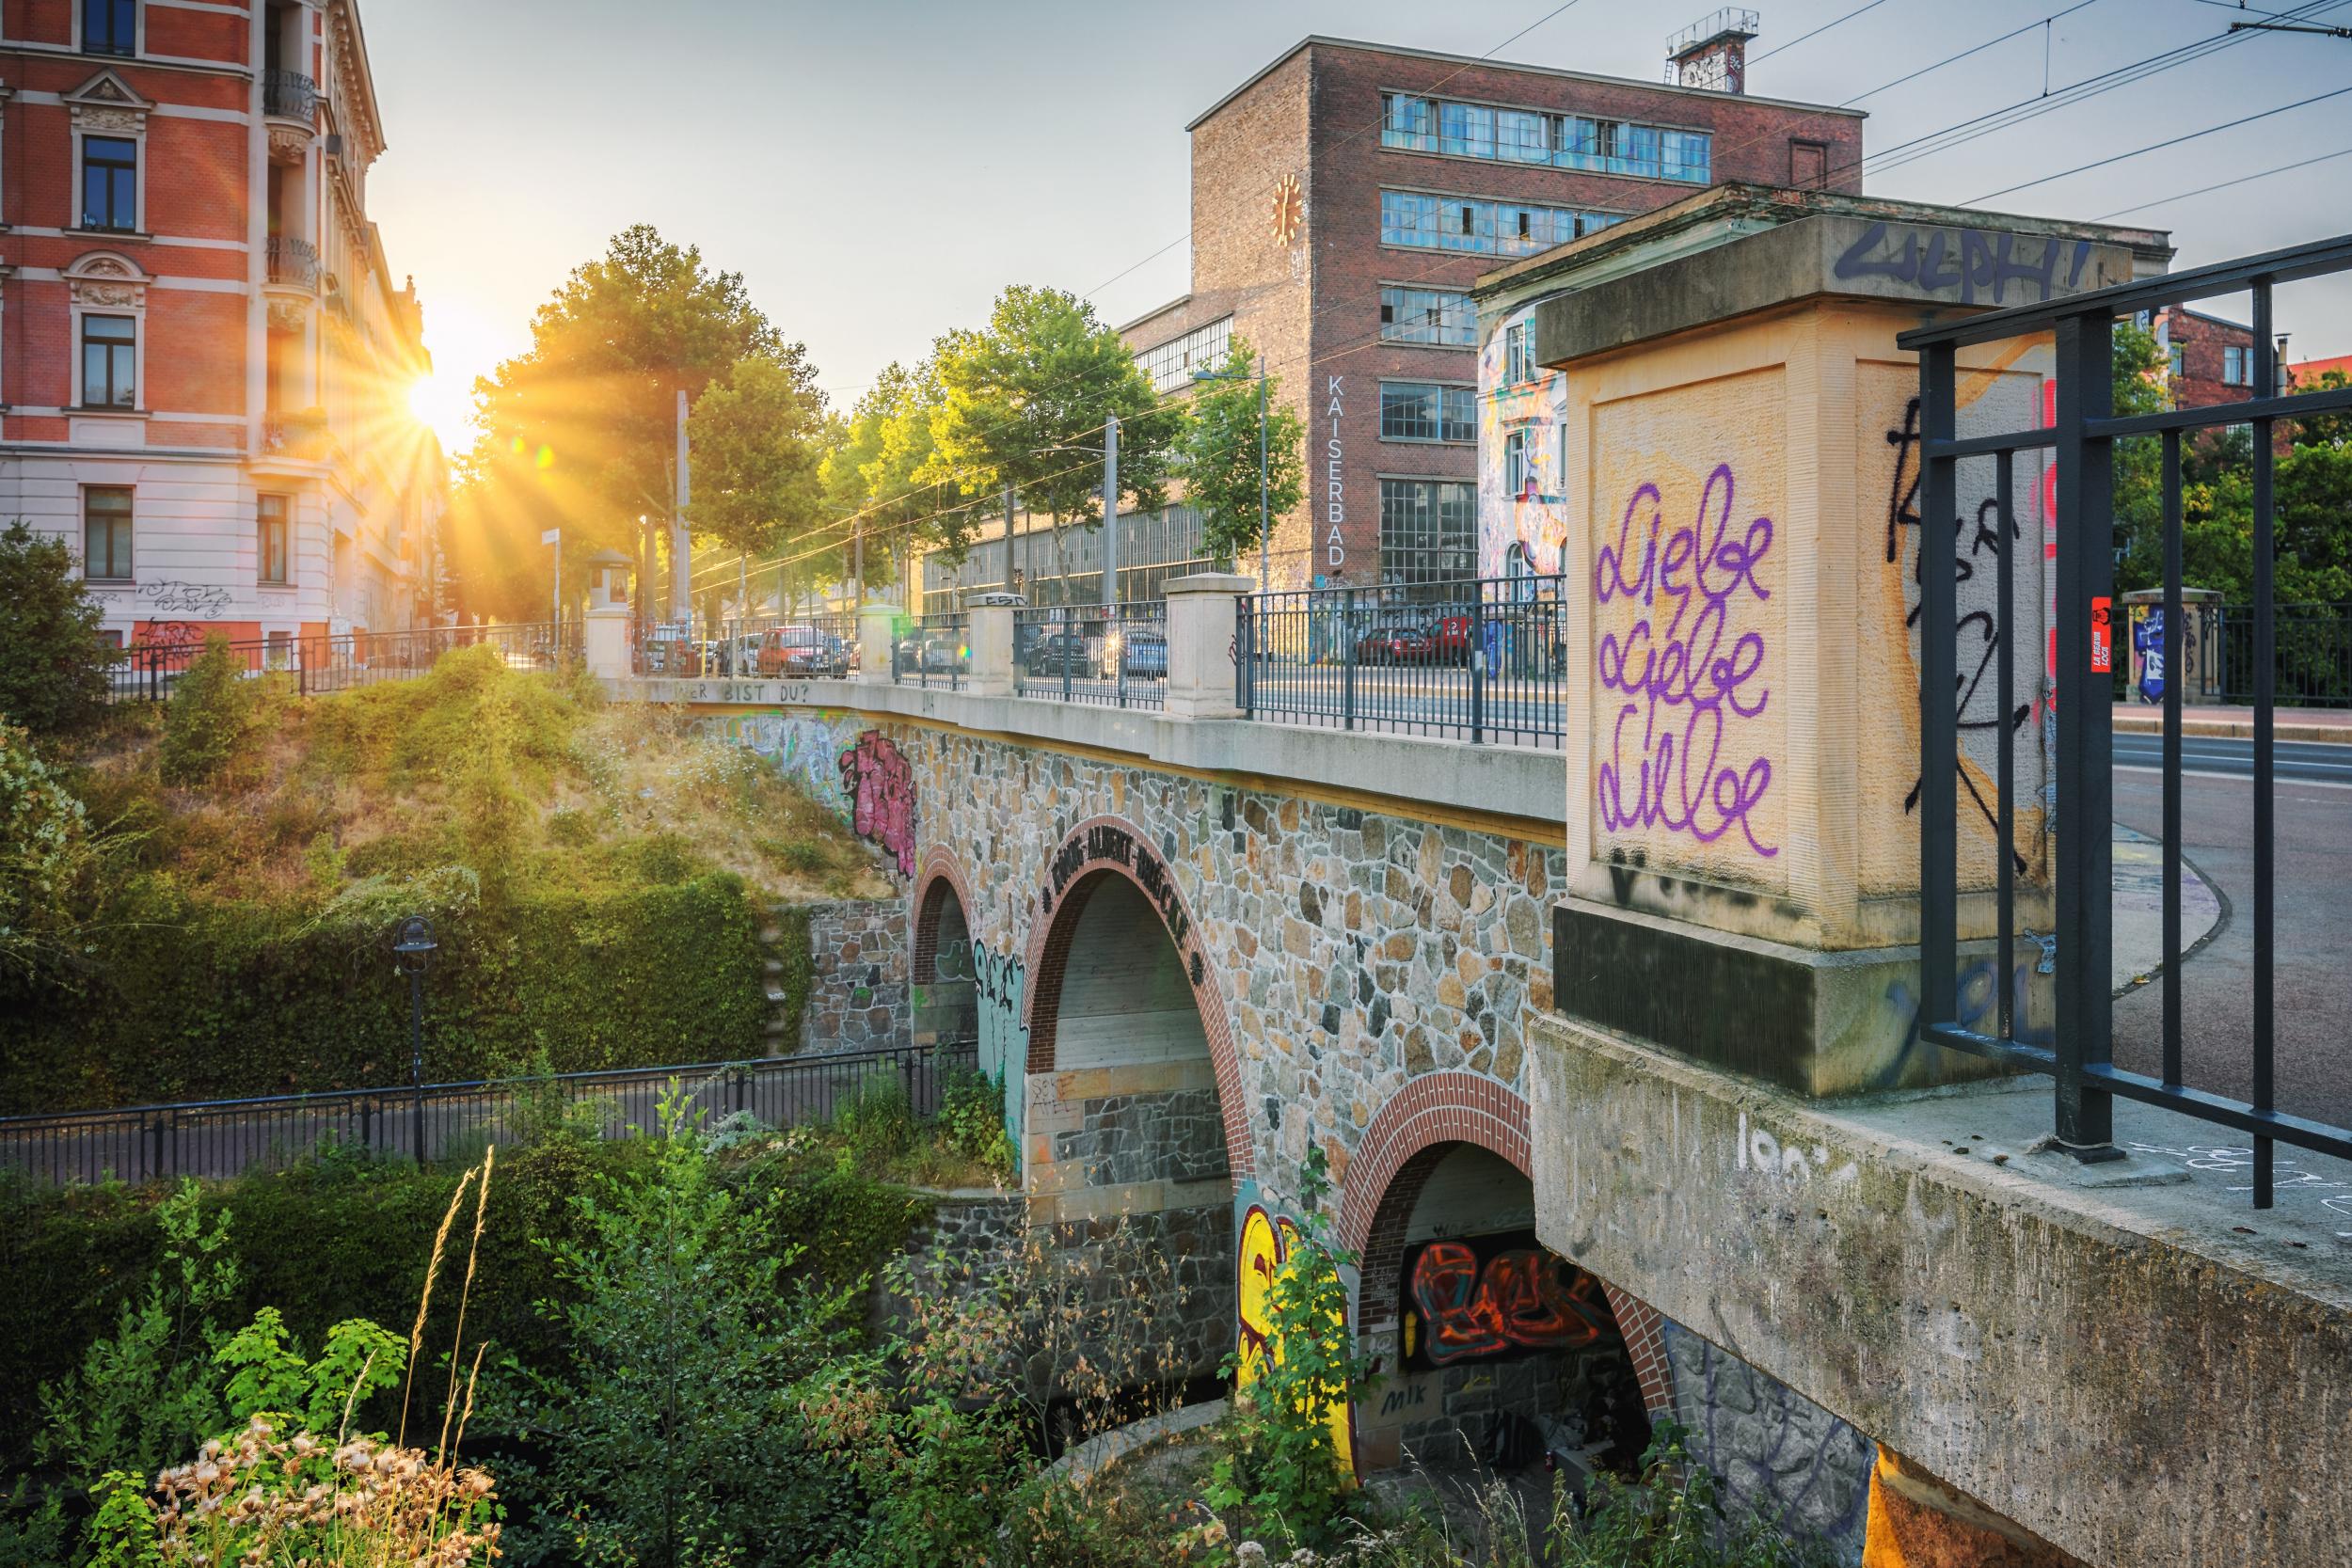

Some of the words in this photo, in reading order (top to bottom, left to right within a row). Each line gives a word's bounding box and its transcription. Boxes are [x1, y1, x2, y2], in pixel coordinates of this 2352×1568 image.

[1327, 375, 1344, 566] KAISERBAD
[1597, 463, 1772, 606] Liebe
[723, 685, 764, 702] BIST
[780, 685, 809, 703] DU?
